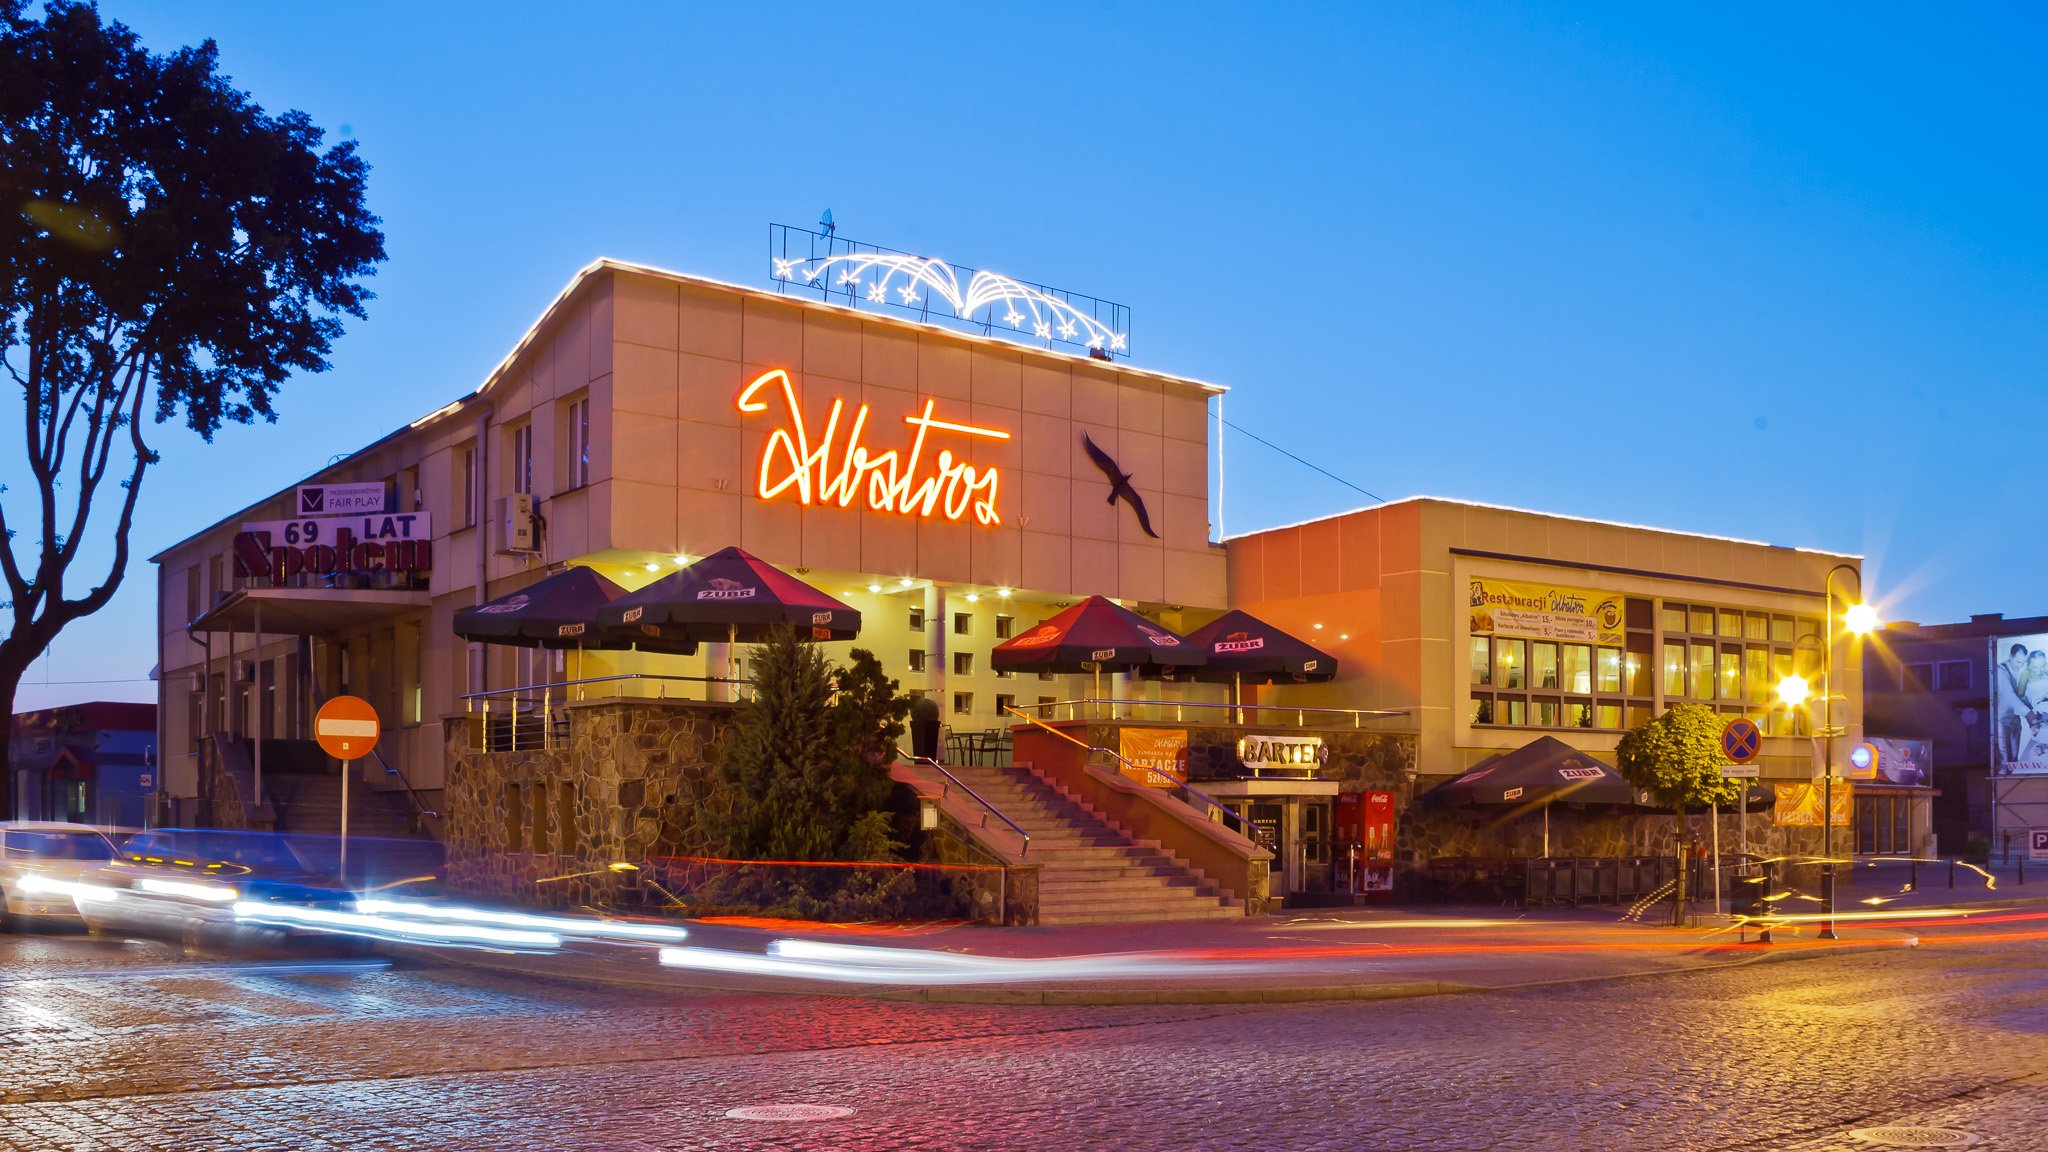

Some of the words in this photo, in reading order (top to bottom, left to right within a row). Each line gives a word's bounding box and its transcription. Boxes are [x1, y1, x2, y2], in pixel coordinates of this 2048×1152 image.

[737, 368, 1011, 525] Albatros
[329, 497, 352, 508] FAIR
[355, 496, 380, 507] PLAY
[285, 521, 319, 544] 69
[364, 515, 416, 539] LAT
[1482, 591, 1546, 611] Restauracji
[1244, 741, 1322, 765] BARTEK
[2037, 834, 2047, 848] P
